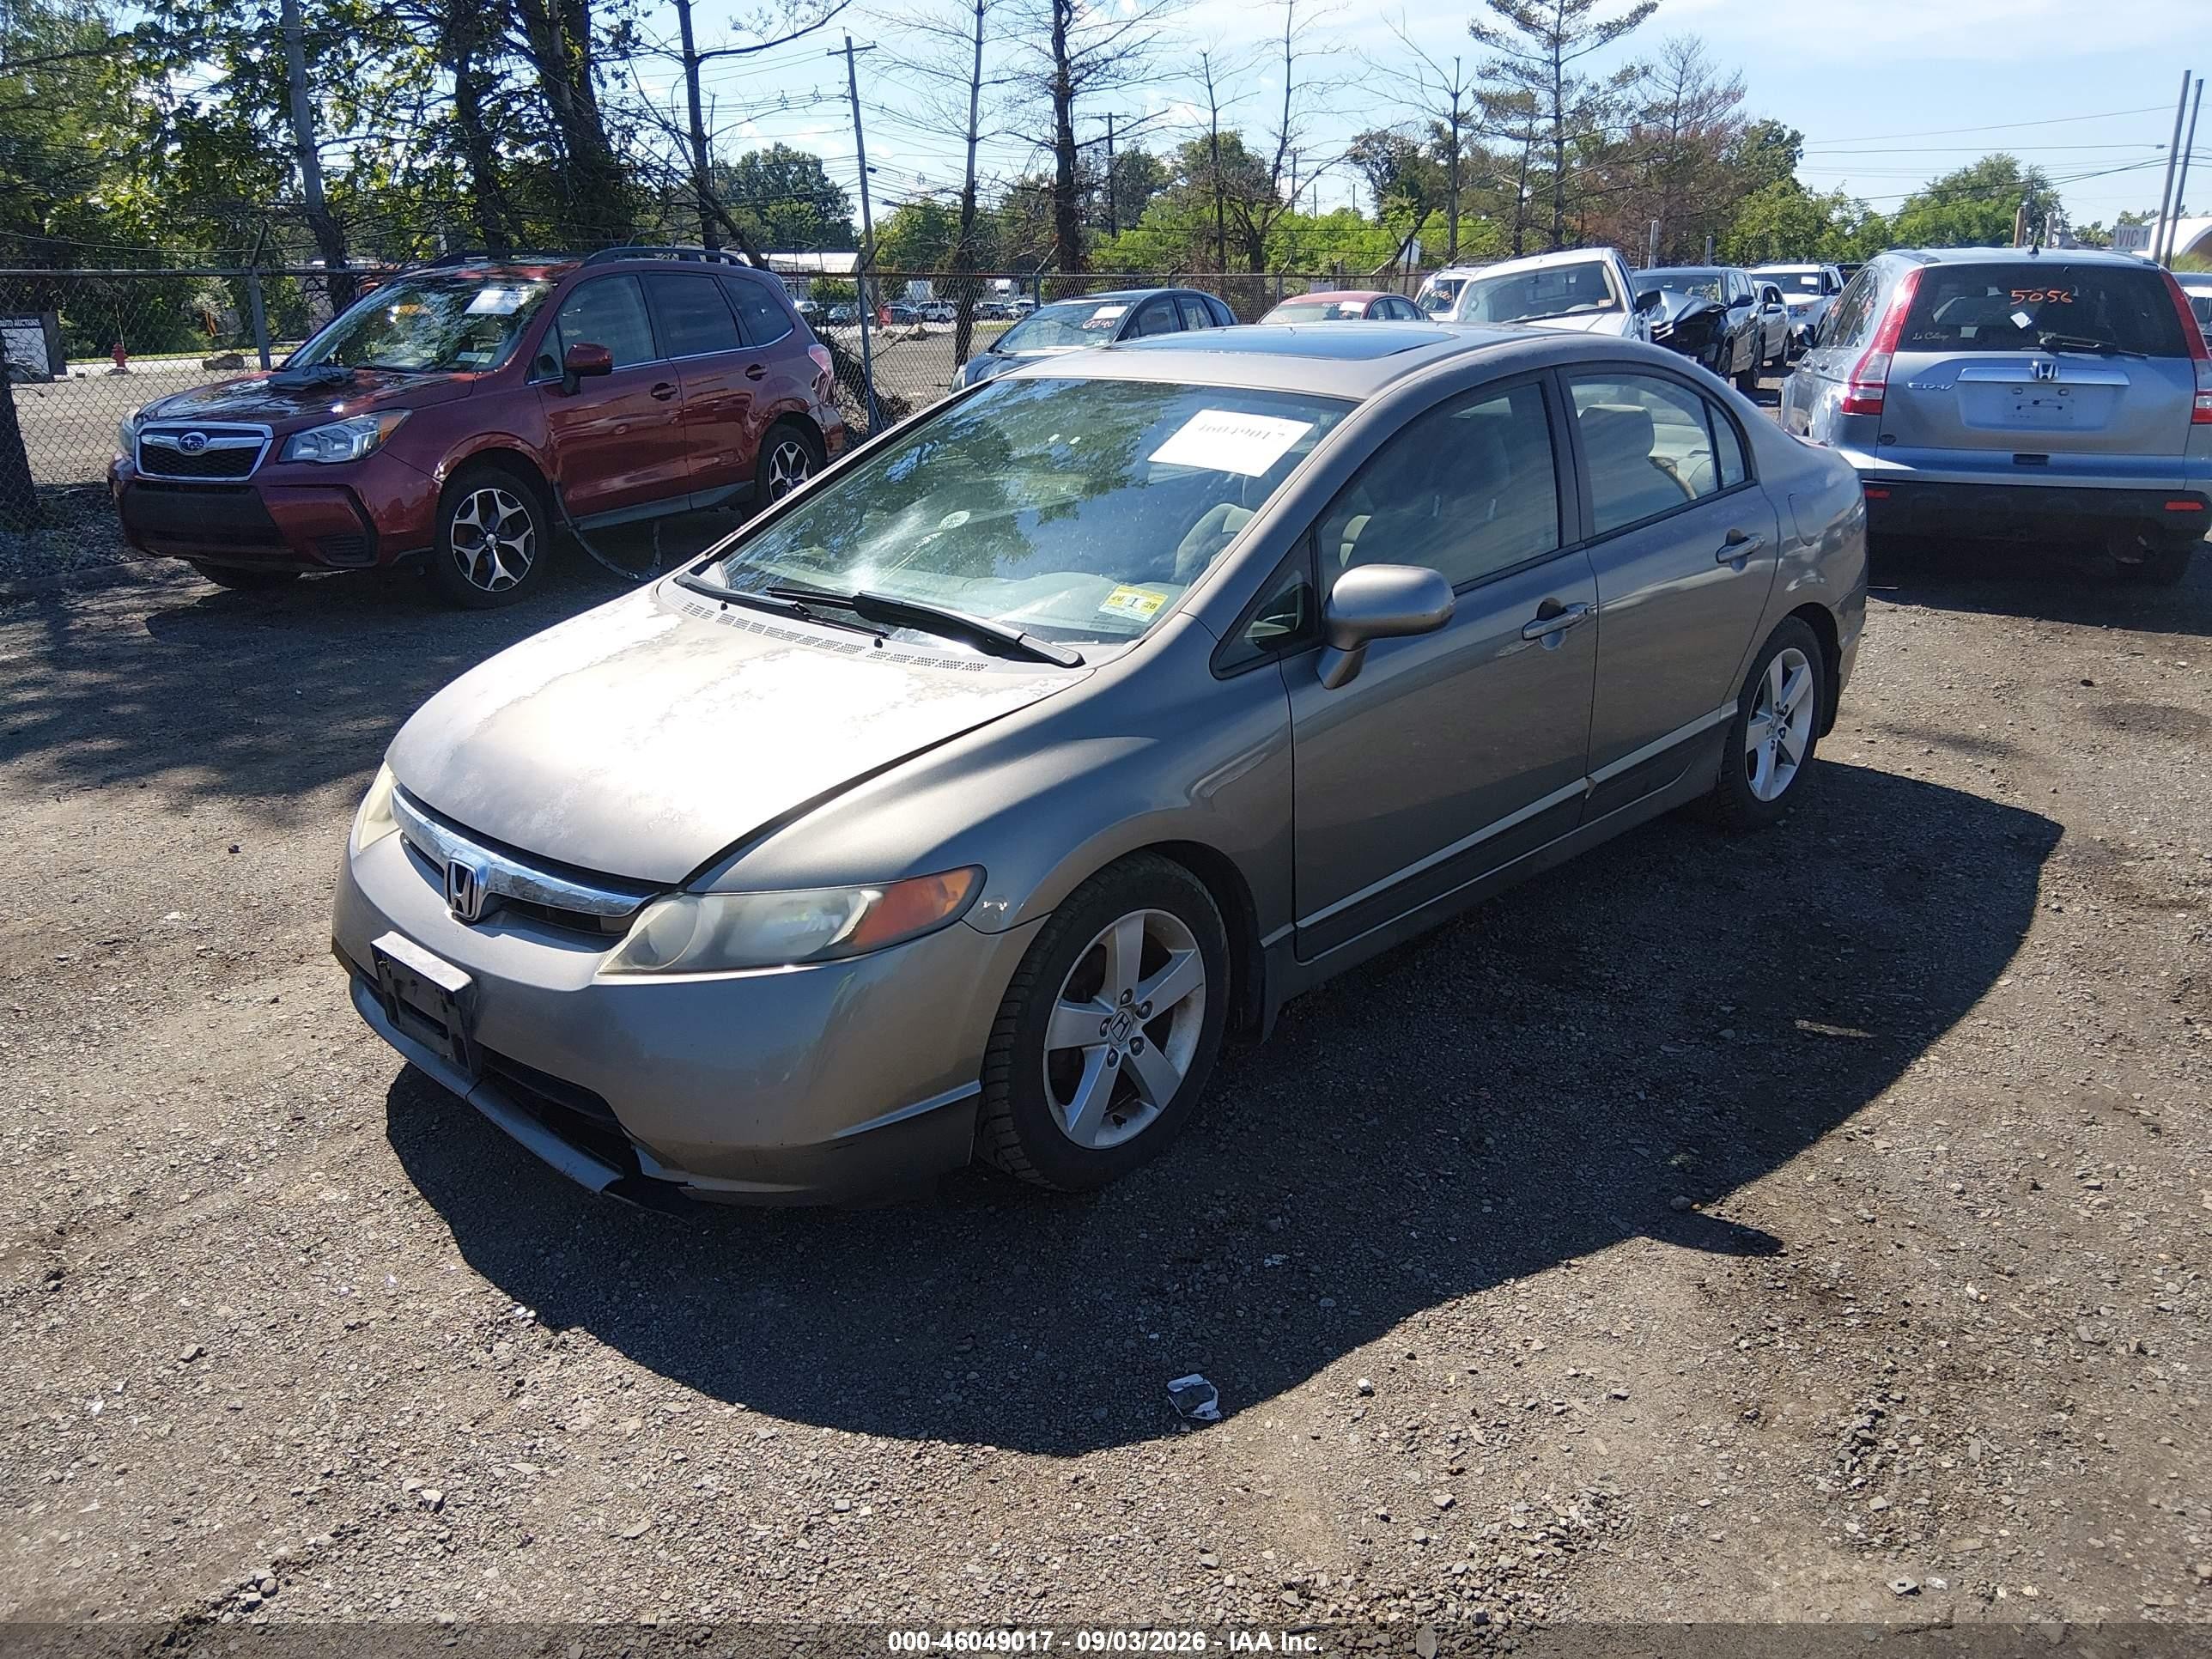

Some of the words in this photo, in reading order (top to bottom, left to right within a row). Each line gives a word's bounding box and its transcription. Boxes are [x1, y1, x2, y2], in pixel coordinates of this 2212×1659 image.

[2118, 229, 2139, 247] VIC
[2142, 230, 2148, 247] 1
[2010, 289, 2073, 305] 5056
